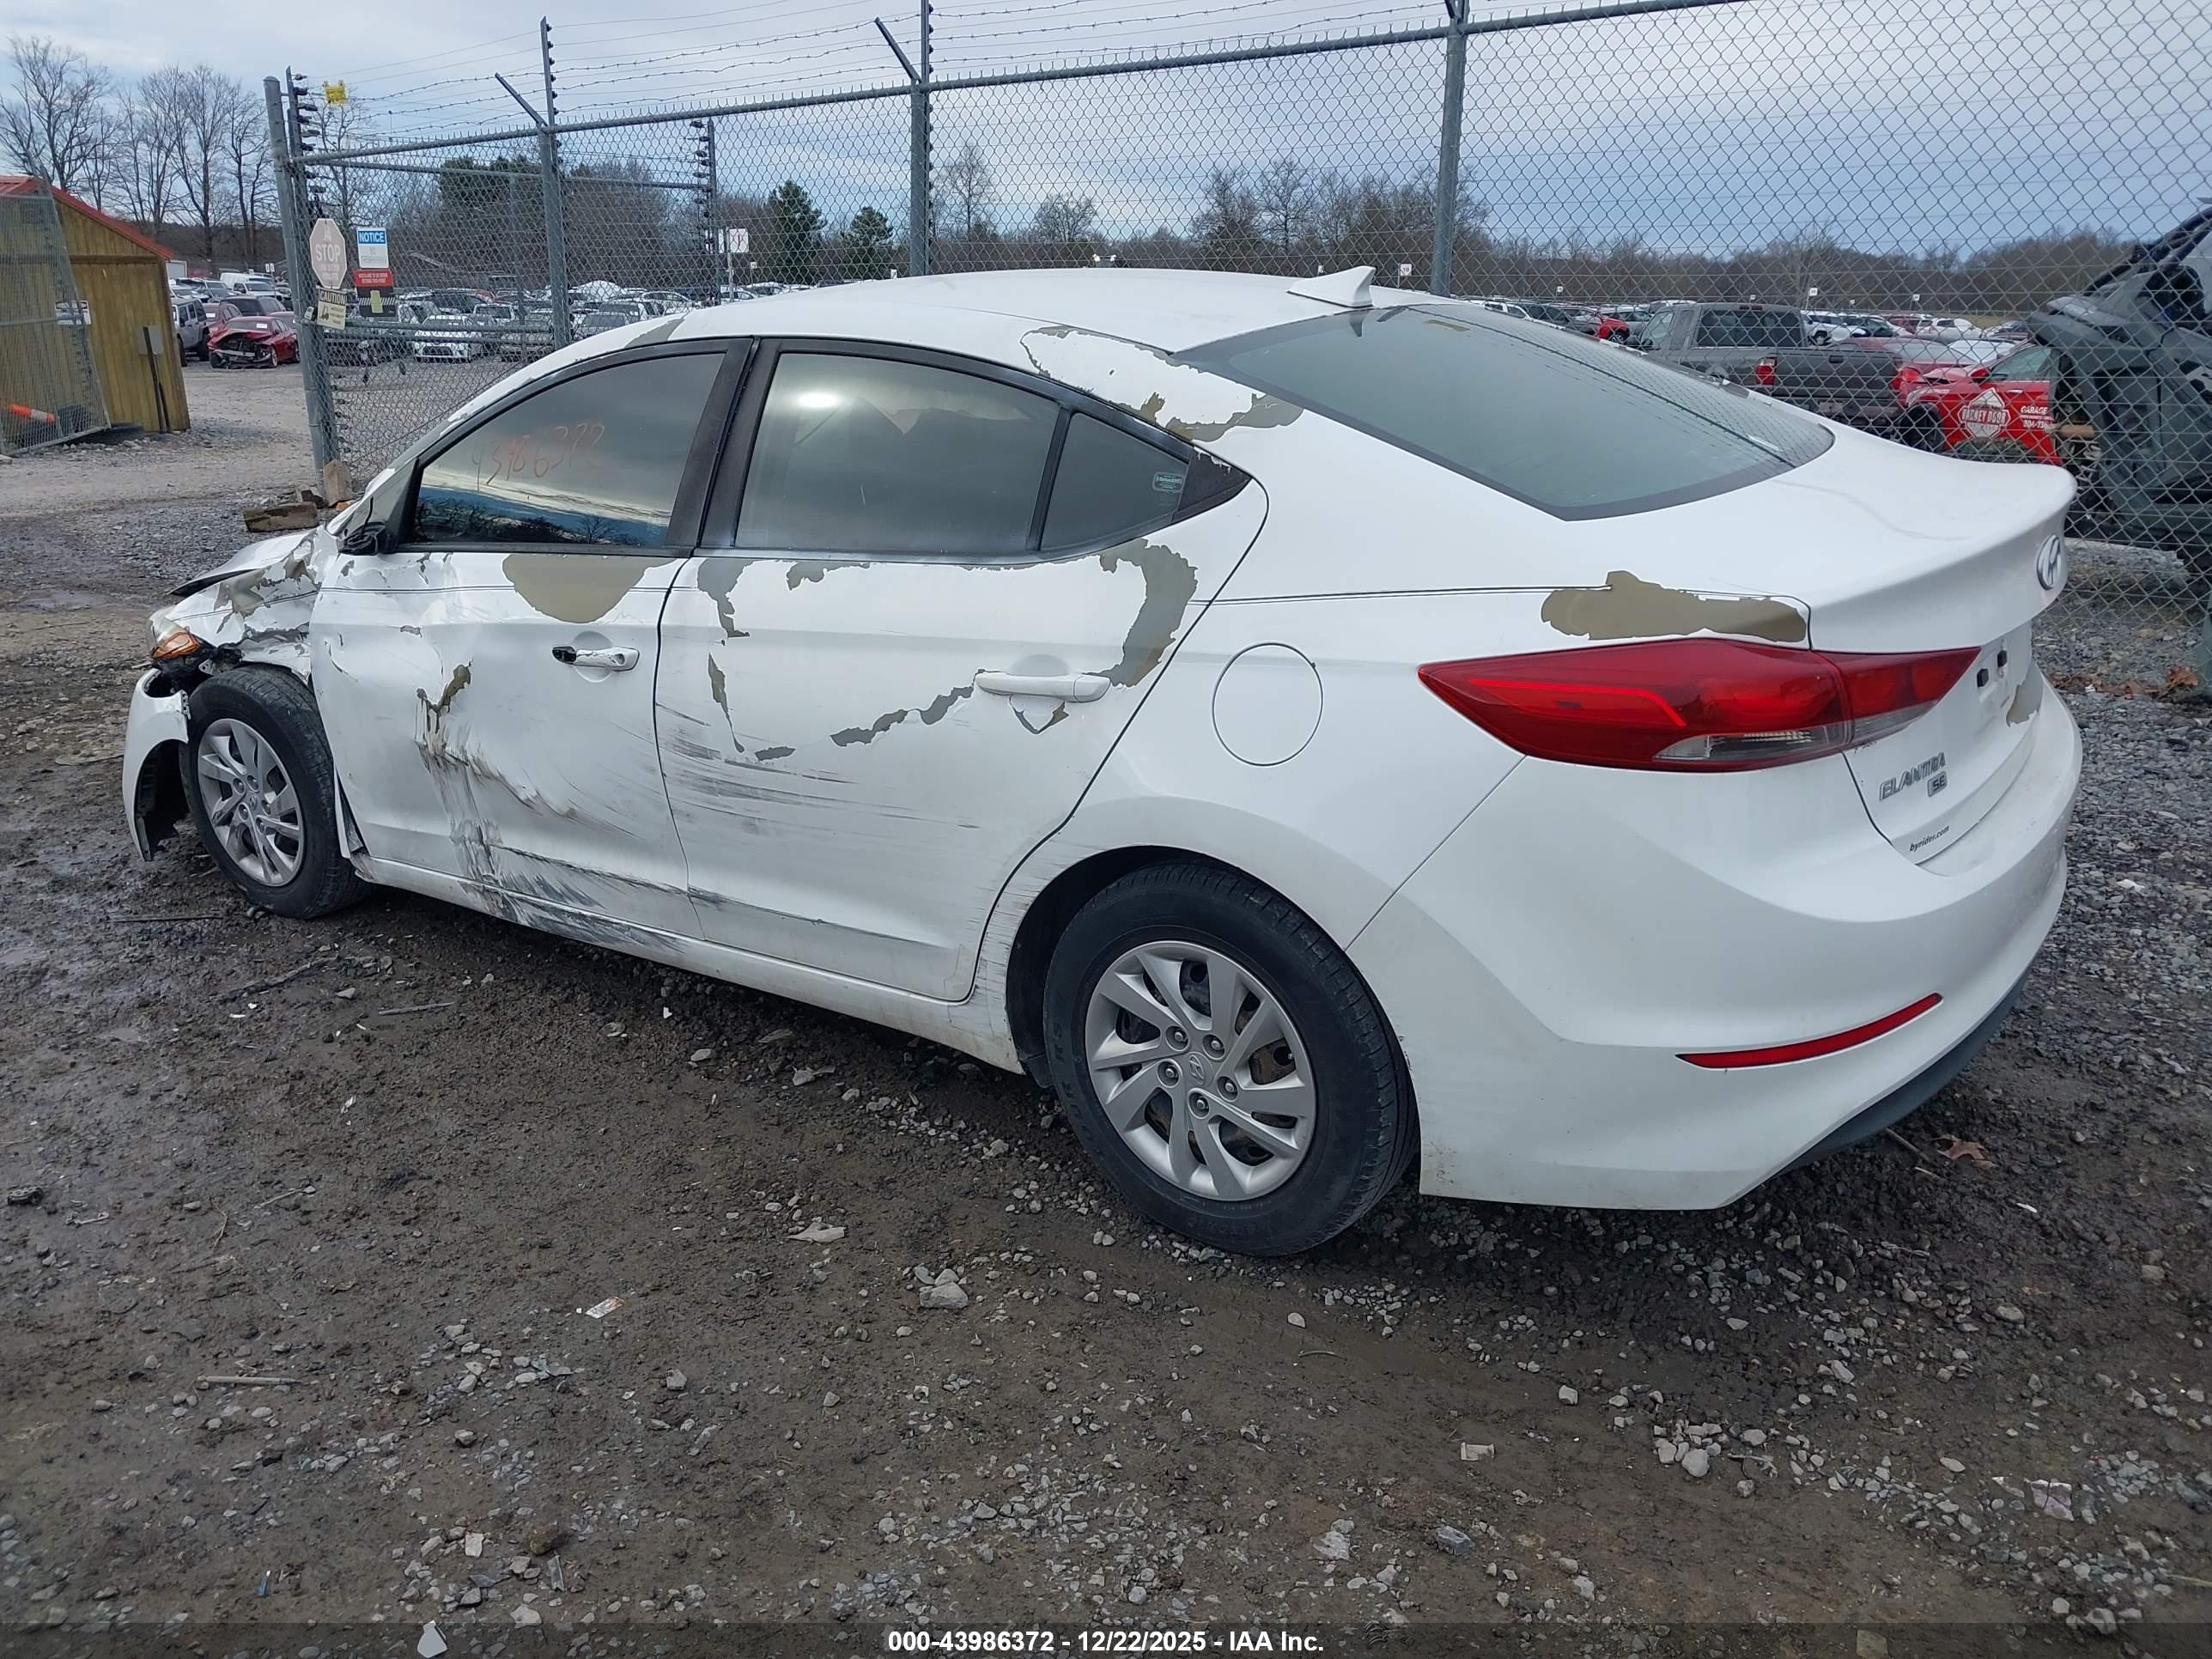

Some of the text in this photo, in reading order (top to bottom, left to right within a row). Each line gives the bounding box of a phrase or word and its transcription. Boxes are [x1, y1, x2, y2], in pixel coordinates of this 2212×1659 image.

[359, 231, 385, 243] NOTICE
[315, 243, 342, 263] STOP
[1879, 751, 1947, 801] ELANTRA
[1932, 775, 1947, 793] SE
[1909, 824, 1950, 853] byrider.com
